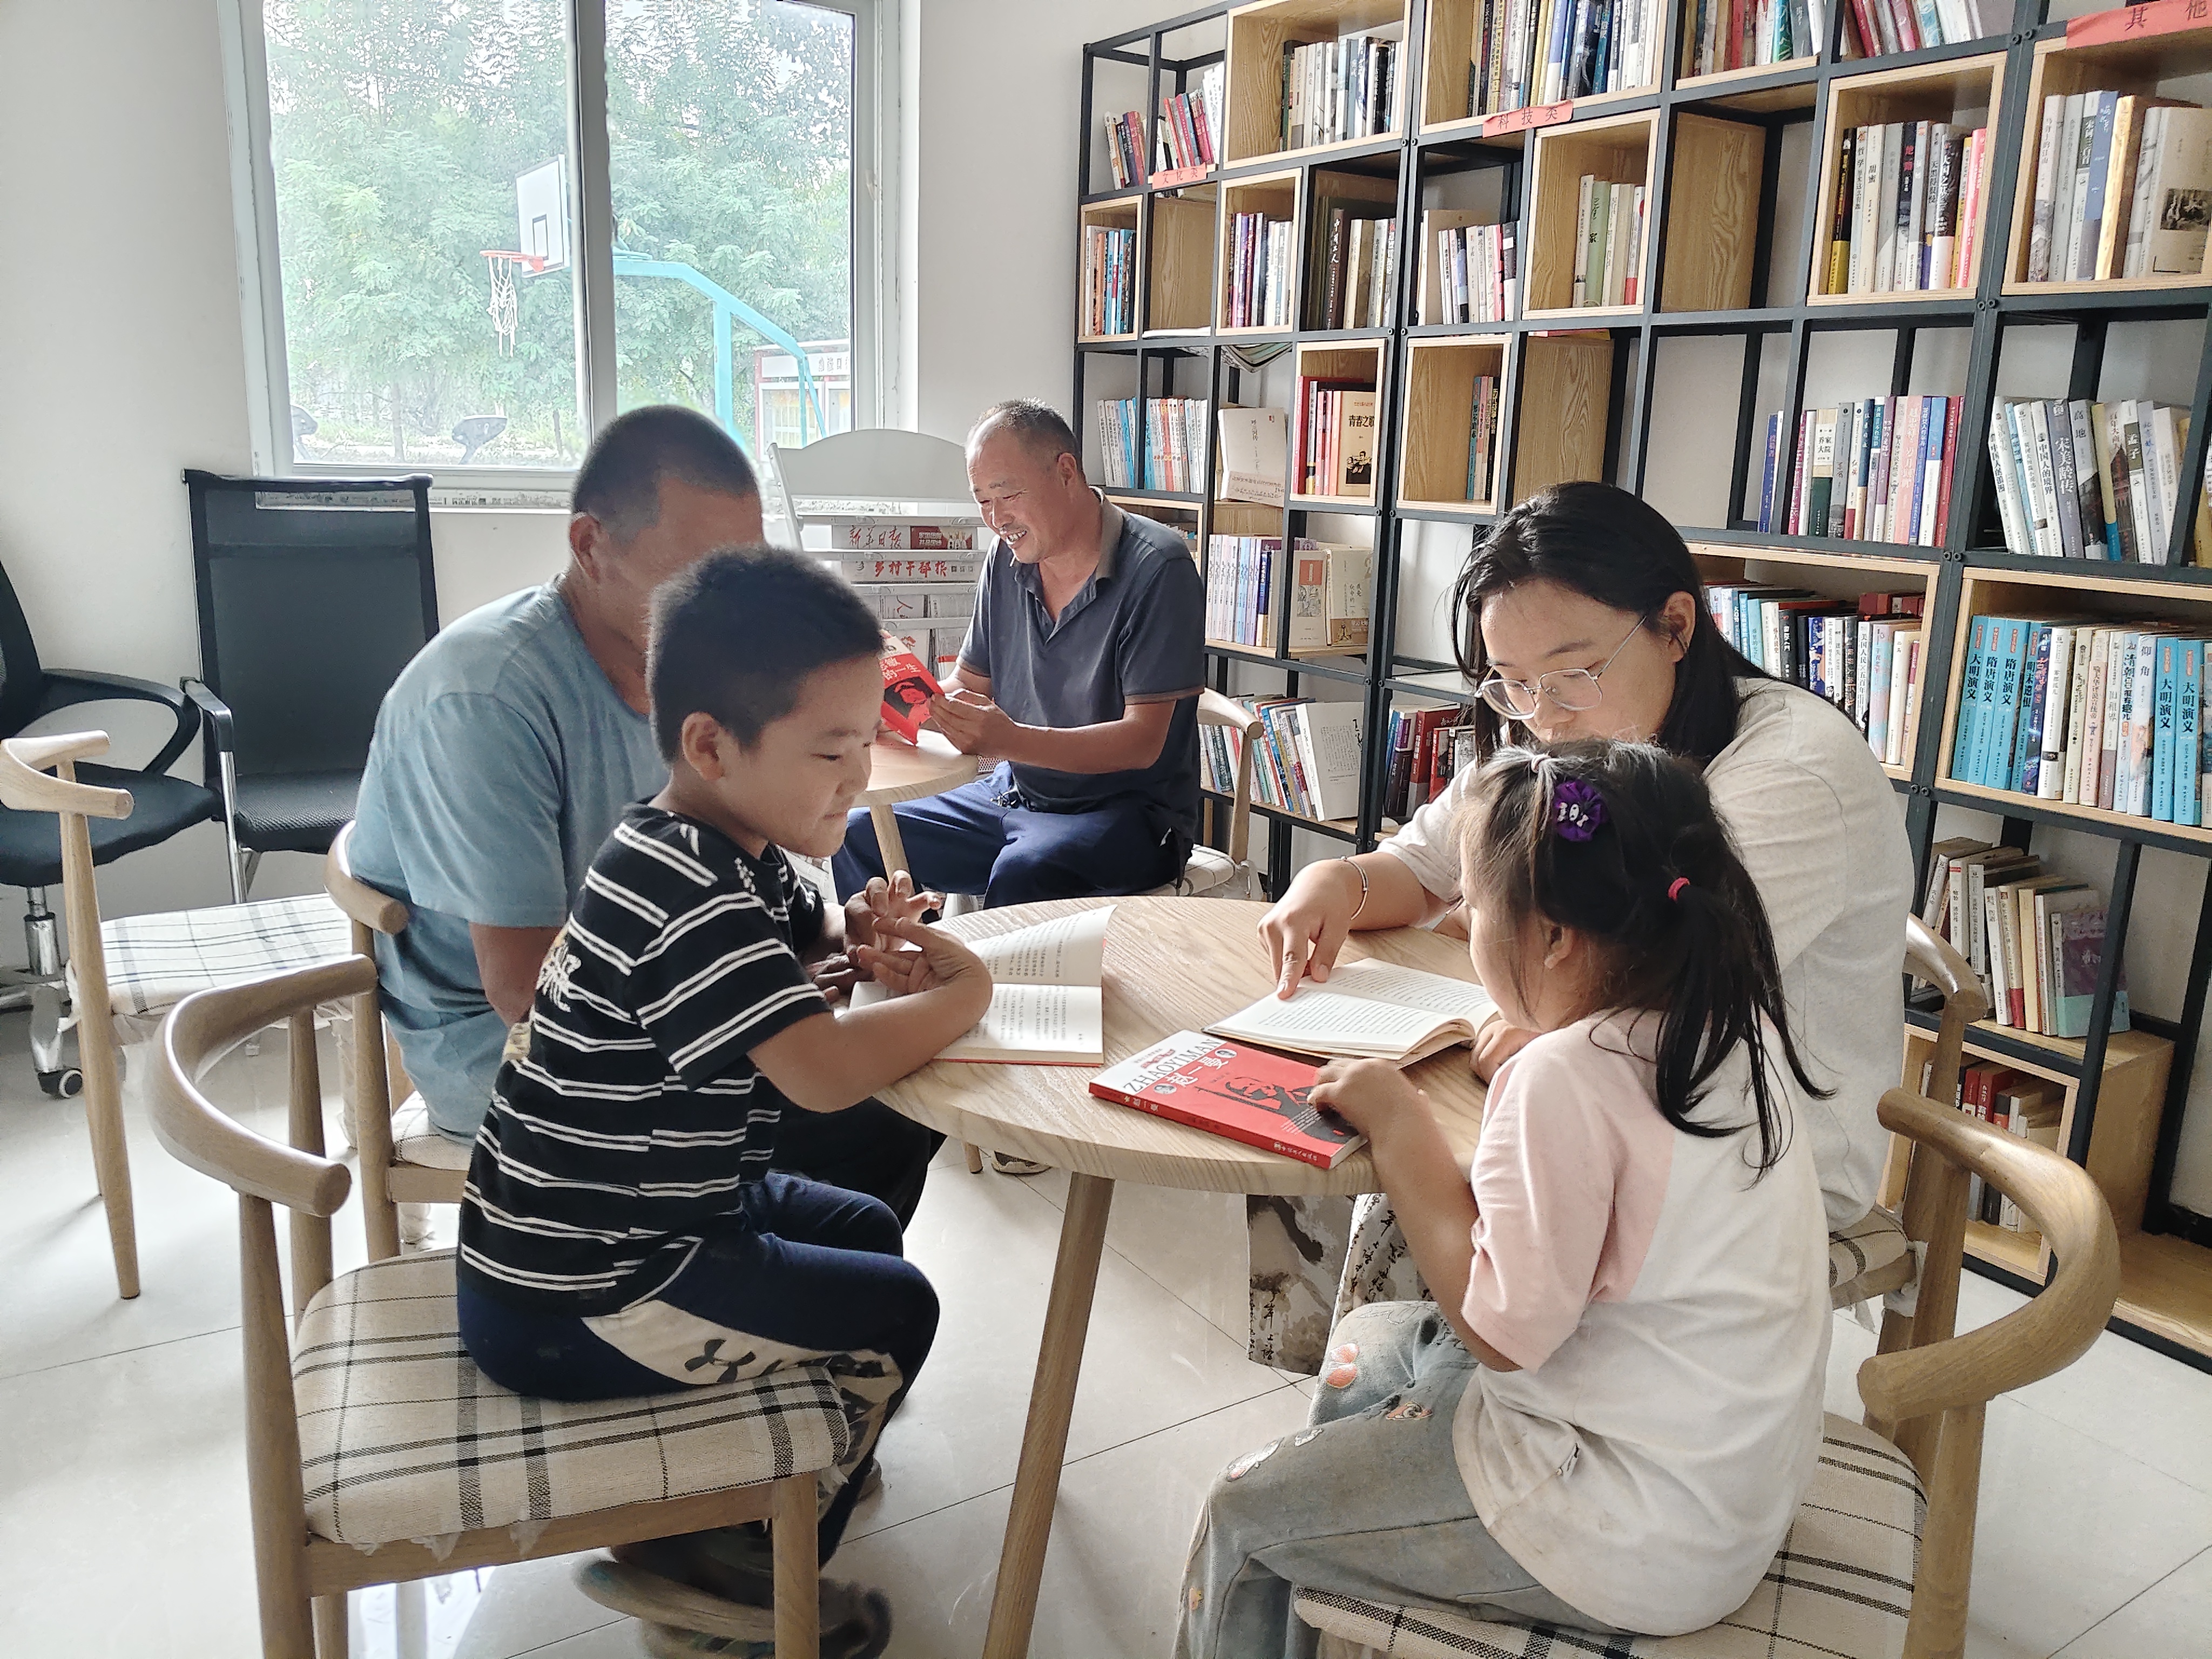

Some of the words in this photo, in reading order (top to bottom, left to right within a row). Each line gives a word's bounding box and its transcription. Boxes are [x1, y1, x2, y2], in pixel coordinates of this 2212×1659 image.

[2125, 0, 2208, 31] 其他
[1497, 107, 1558, 130] 科技类
[1348, 414, 1375, 427] 青春之歌
[2055, 436, 2074, 495] 宋美龄传
[2128, 433, 2140, 461] 孟子
[1965, 653, 1981, 700] 大明演义
[1982, 656, 1998, 702] 隋唐演义
[2001, 658, 2017, 705] 隋唐演义
[2160, 678, 2173, 729] 大明演义
[2182, 682, 2195, 733] 大明演义
[1123, 1038, 1222, 1092] ZHAOYIMAN
